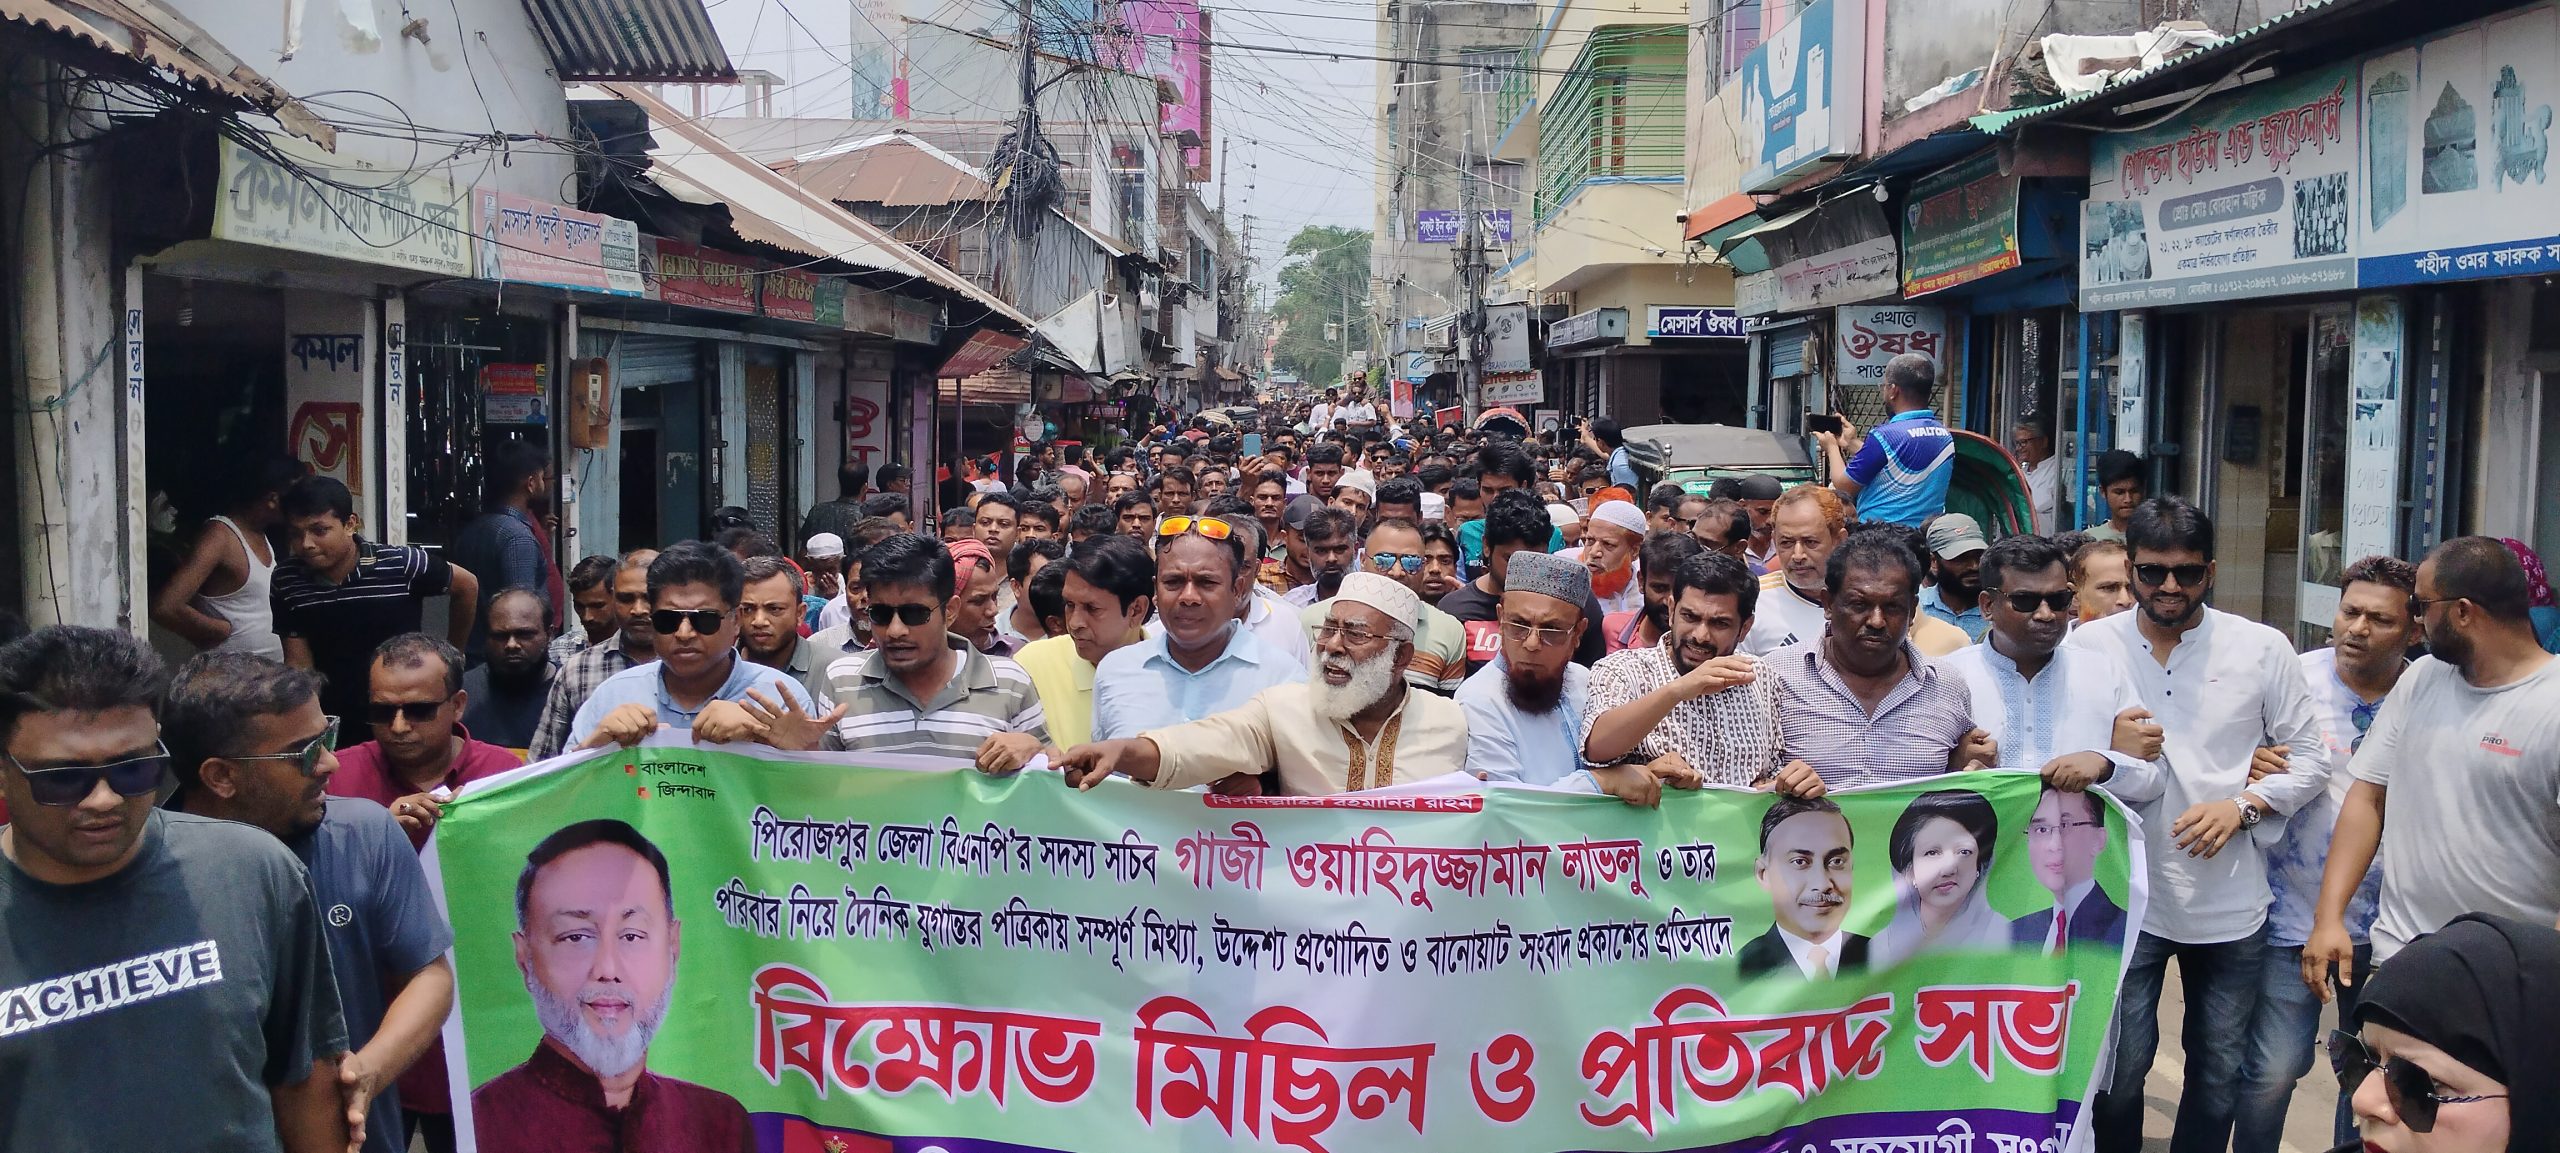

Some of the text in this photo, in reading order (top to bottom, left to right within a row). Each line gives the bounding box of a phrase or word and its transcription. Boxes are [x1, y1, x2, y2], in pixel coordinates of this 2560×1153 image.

[2414, 251, 2451, 276] শহীদ
[2455, 252, 2489, 270] ওমর
[2492, 246, 2543, 268] ফারুক
[1660, 309, 1702, 335] মেসার্স
[1706, 313, 1737, 335] ঔষধ
[1870, 311, 1917, 328] এখানে
[291, 333, 363, 372] কমল
[1841, 319, 1941, 360] ঔষধ
[1906, 426, 1949, 438] WALTON
[1472, 626, 1501, 652] Lo
[2482, 735, 2503, 746] PRO
[640, 760, 707, 778] বাংলাদেশ
[656, 780, 717, 801] জিন্দাবাদ
[752, 806, 868, 869] পিরোজপুর
[878, 820, 932, 869] জেলা
[1039, 836, 1097, 879] সদস্য
[1105, 829, 1159, 885] সচিব
[1175, 821, 1272, 892] গাজী
[1286, 826, 1552, 911] ওয়াহিদুজ্জামান
[1557, 835, 1648, 899] লাভলু
[1656, 849, 1672, 869] ও
[1676, 841, 1716, 881] তার
[716, 884, 1734, 978] পরিবার নিয়ে দৈনিক যুগান্তর পত্রিকায় সম্পূর্ণ মিথ্যা, উদ্দেশ্য প্রণোদিত ও বানোয়াট সংবাদ প্রকাশের প্রতিবাদে
[4, 946, 217, 1029] ACHIEVE
[752, 964, 2079, 1153] বিক্ষোভ মিছিল ও প্রতিবাদ সভা
